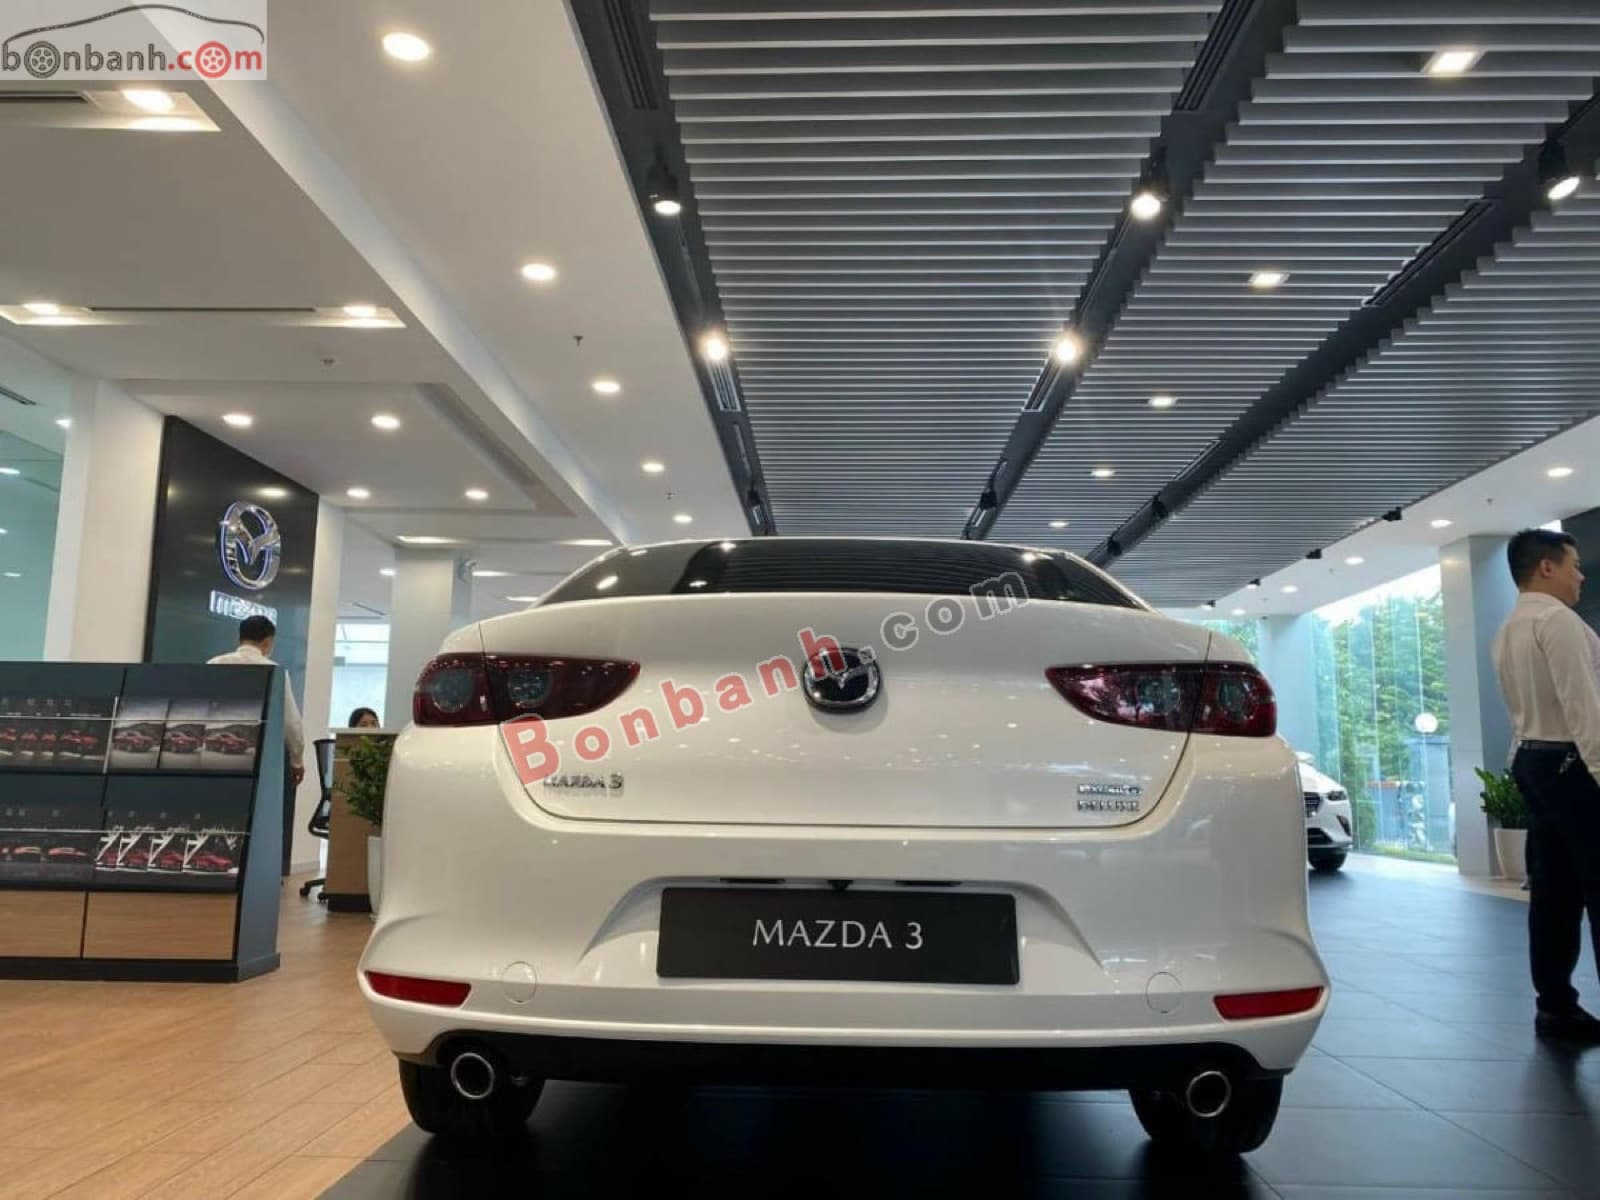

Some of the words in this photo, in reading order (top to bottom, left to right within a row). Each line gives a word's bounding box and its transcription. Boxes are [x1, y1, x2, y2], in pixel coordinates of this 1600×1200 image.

[608, 773, 624, 789] 3
[753, 919, 893, 949] MAZDA
[905, 921, 924, 950] 3
